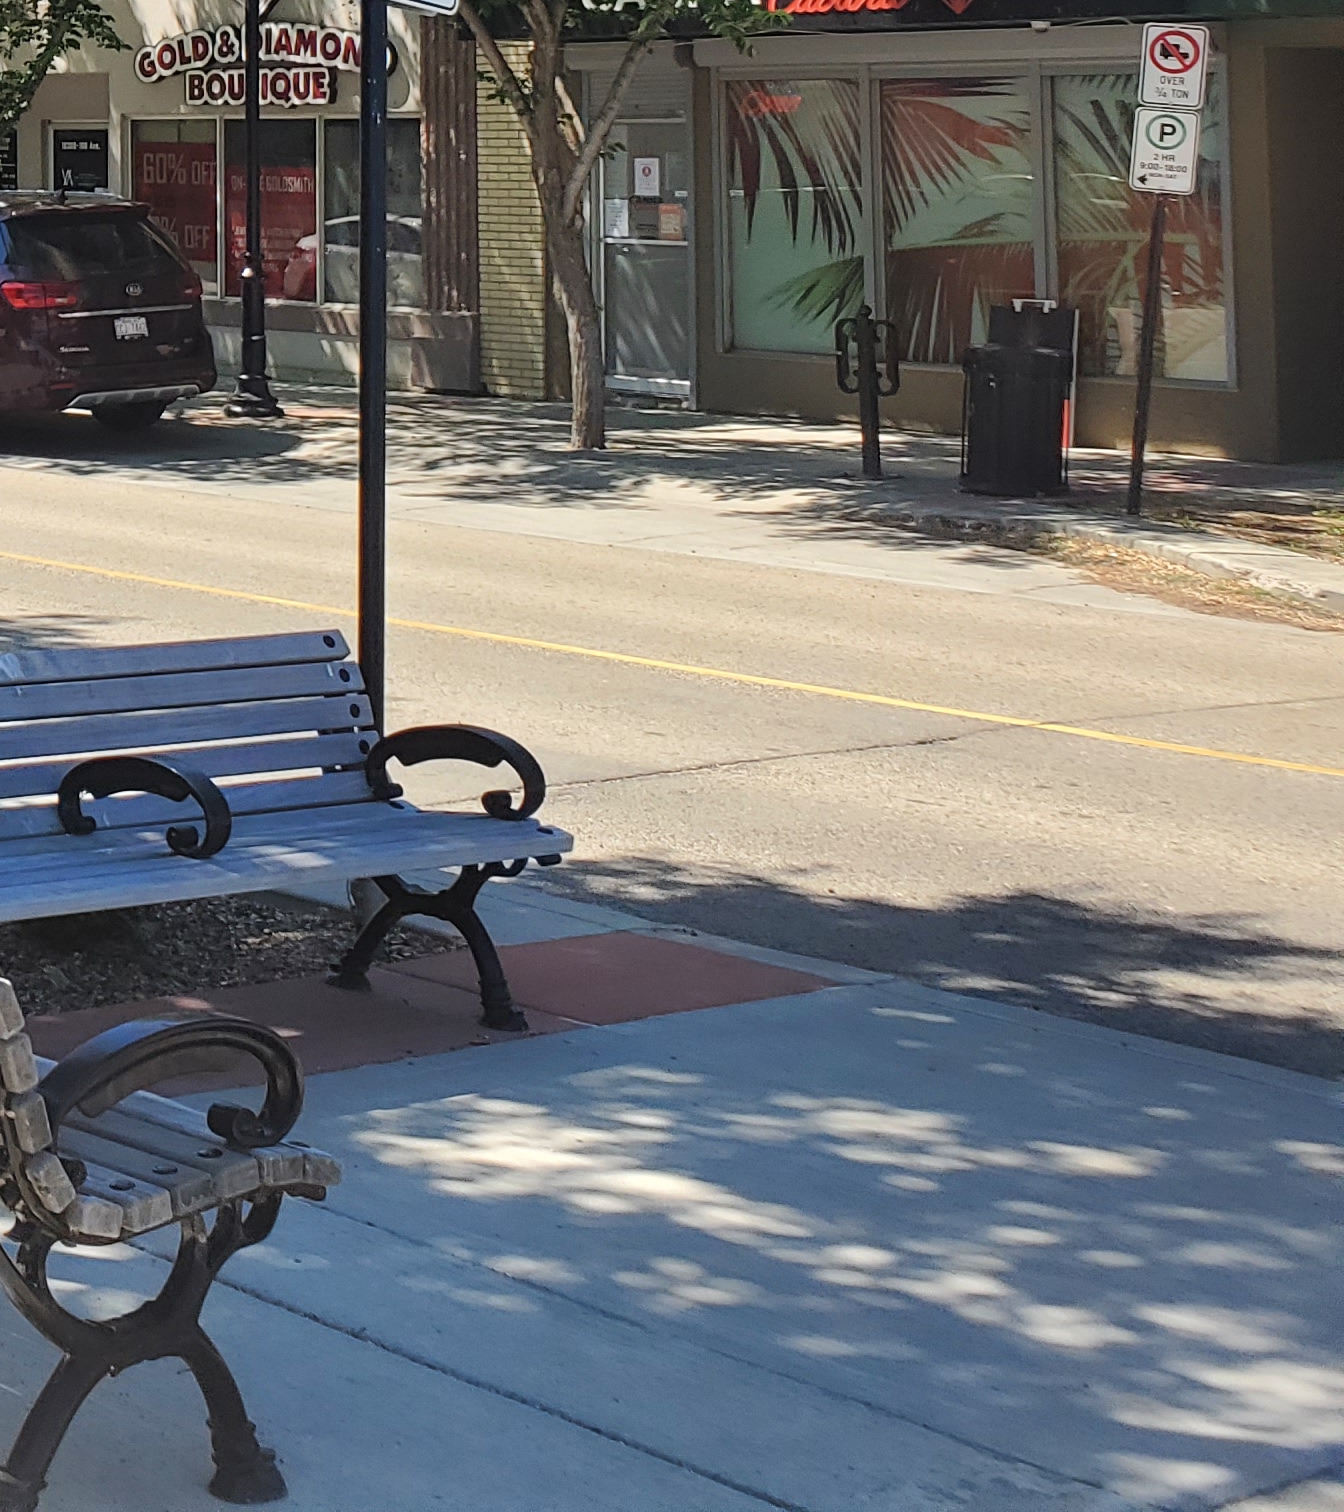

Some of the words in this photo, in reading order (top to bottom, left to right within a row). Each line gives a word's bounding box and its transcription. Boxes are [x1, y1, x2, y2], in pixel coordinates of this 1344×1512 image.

[139, 34, 210, 78] GOLD
[217, 29, 236, 58] &
[242, 27, 391, 70] IAMON
[188, 71, 327, 103] BOUIQUE
[1159, 75, 1185, 86] OVER
[1171, 88, 1190, 99] TON
[1159, 123, 1177, 143] P
[143, 153, 187, 185] 60%
[1153, 153, 1159, 161] 2
[1161, 154, 1175, 163] HR
[184, 224, 210, 249] OFF
